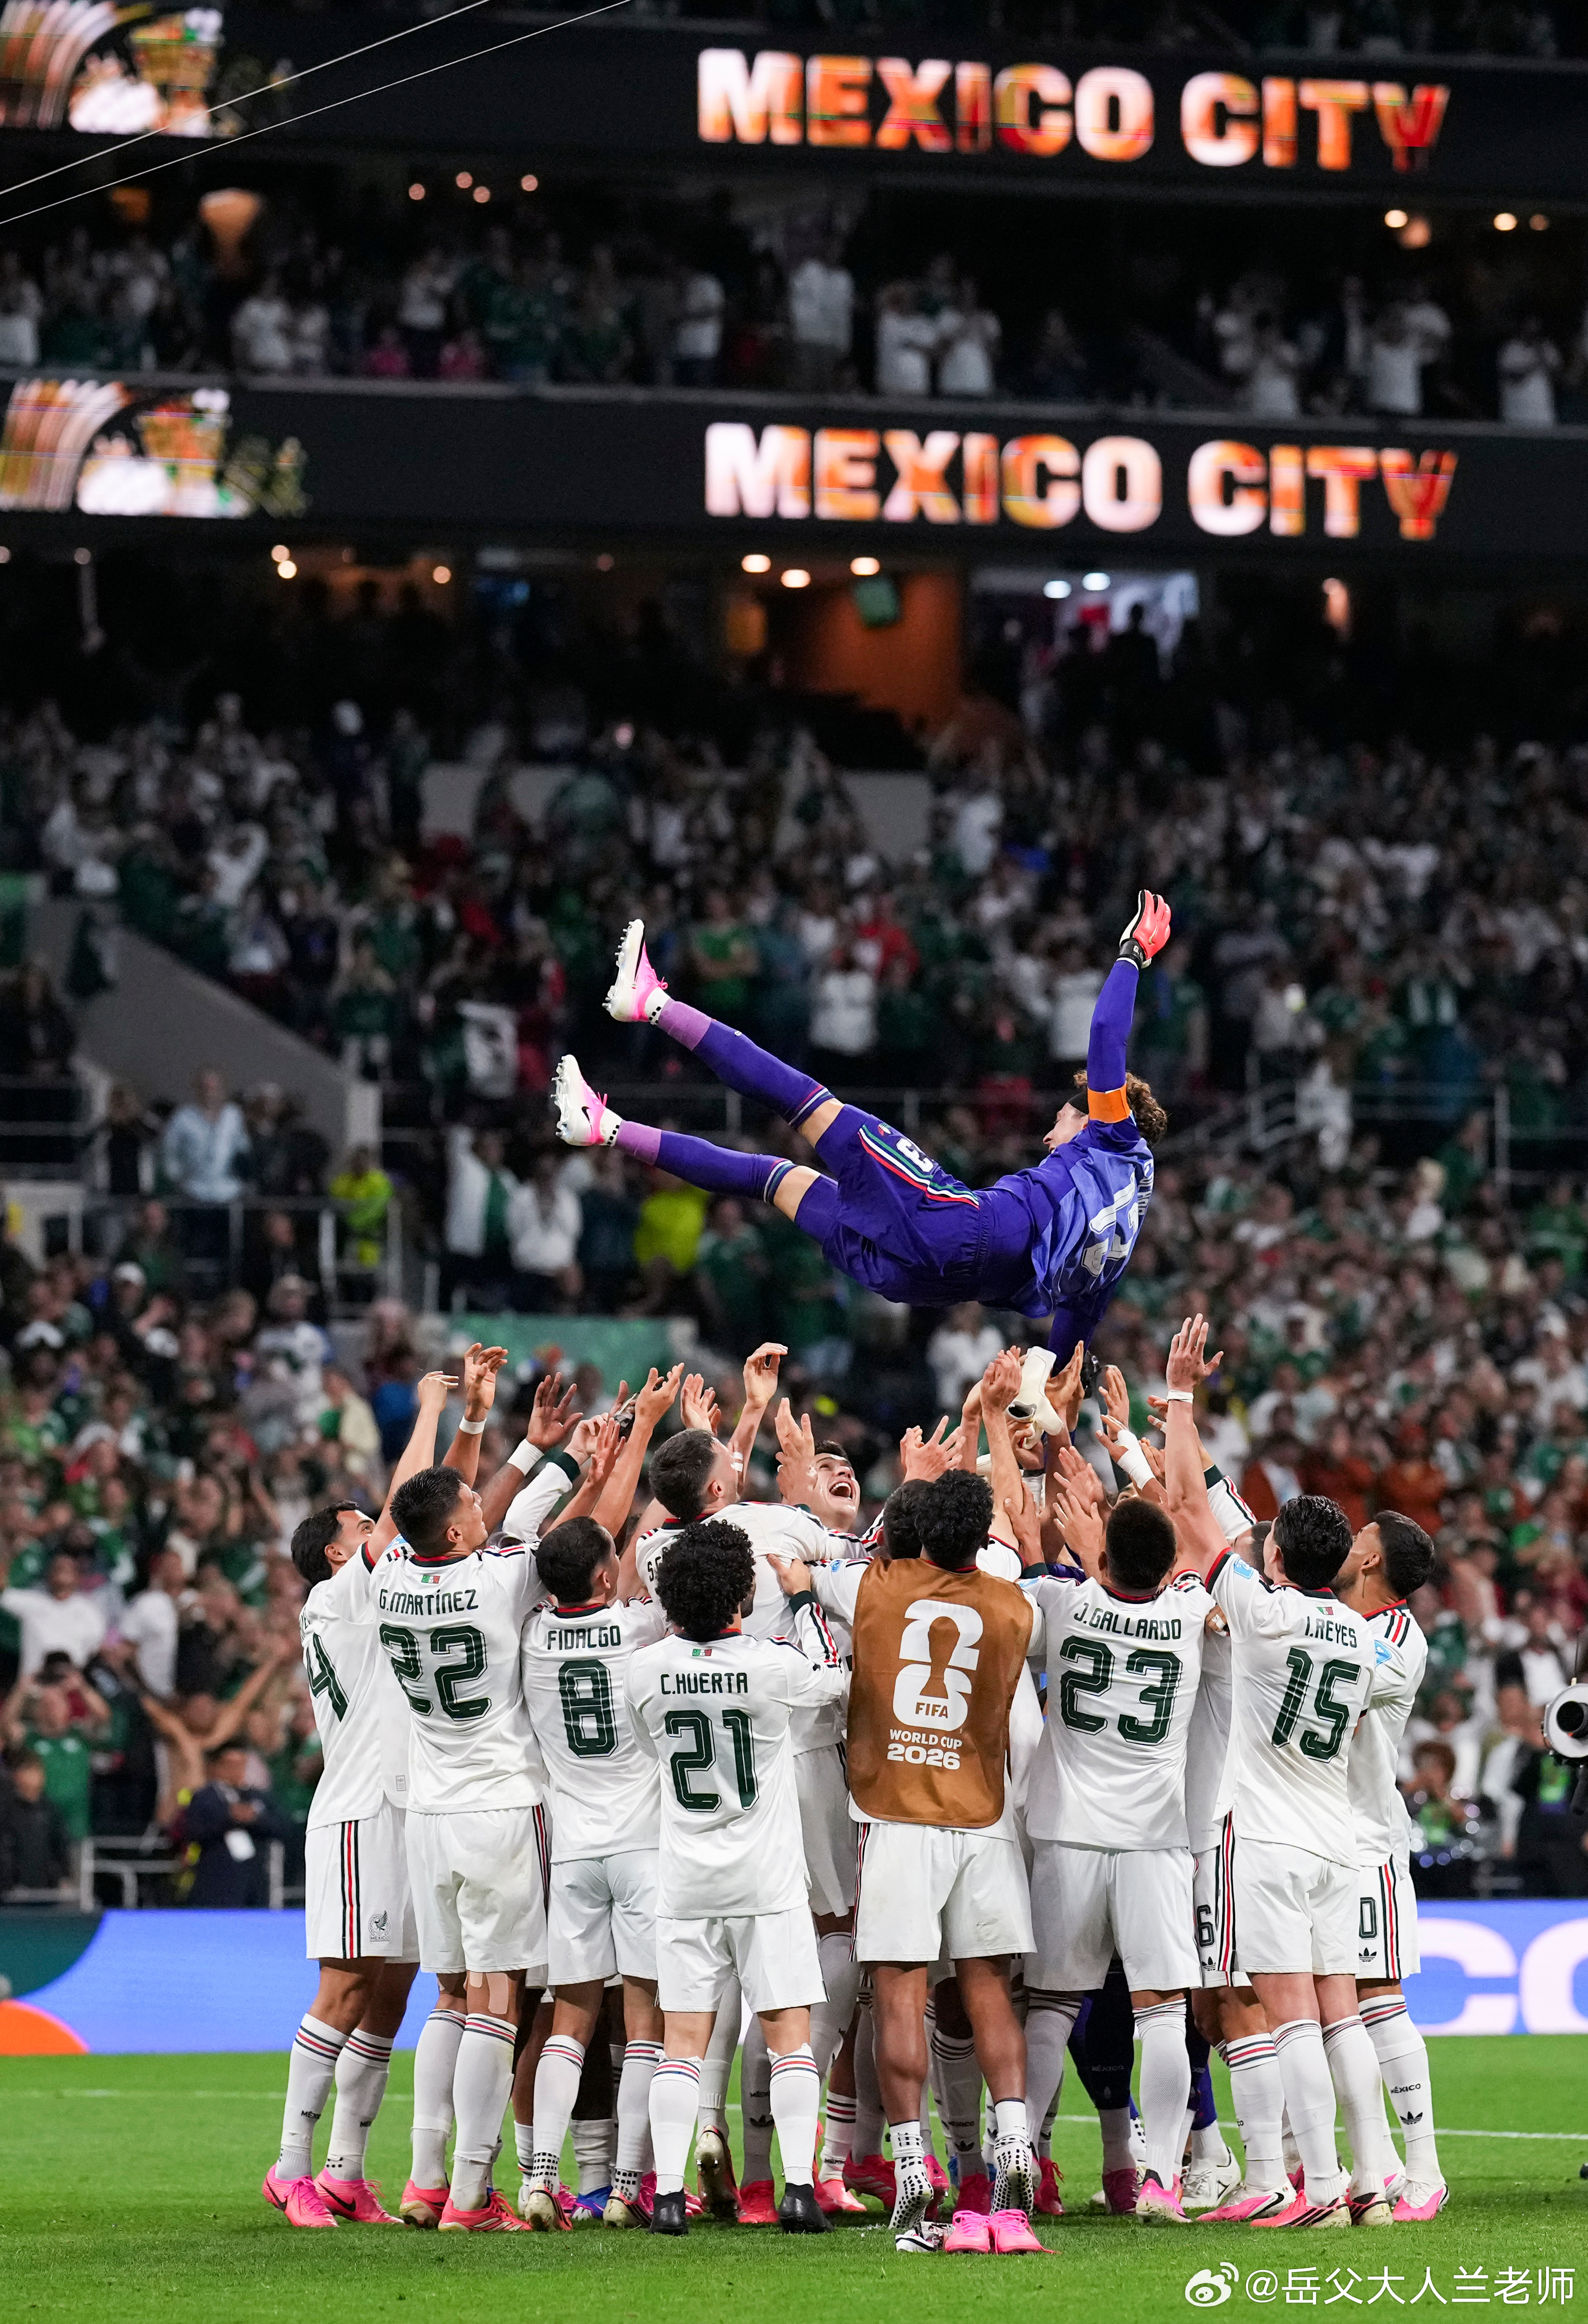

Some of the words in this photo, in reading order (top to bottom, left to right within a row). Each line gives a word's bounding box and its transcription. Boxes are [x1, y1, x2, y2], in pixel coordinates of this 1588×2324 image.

[698, 49, 1155, 161] MEXICO
[1180, 72, 1450, 171] CITY
[705, 423, 1162, 531] MEXICO
[1188, 439, 1458, 540] CITY
[380, 1588, 479, 1615] G.MARTÍNEZ
[1074, 1603, 1181, 1640] J.GALLARDO
[547, 1625, 621, 1650] FIDALGO
[1305, 1616, 1357, 1648] I.REYES
[306, 1632, 350, 1722] 4
[379, 1623, 492, 1722] 22
[661, 1672, 748, 1694] C.HUERTA
[1060, 1635, 1183, 1746] 23
[558, 1659, 619, 1758] 8
[915, 1702, 948, 1718] FIFA
[1271, 1647, 1361, 1763] 15
[887, 1743, 960, 1770] 2026
[889, 1729, 939, 1745] WORLD
[941, 1735, 963, 1750] CUP
[665, 1709, 760, 1813] 21
[1197, 1904, 1217, 1948] 6
[1390, 2083, 1421, 2094] MÉXICO
